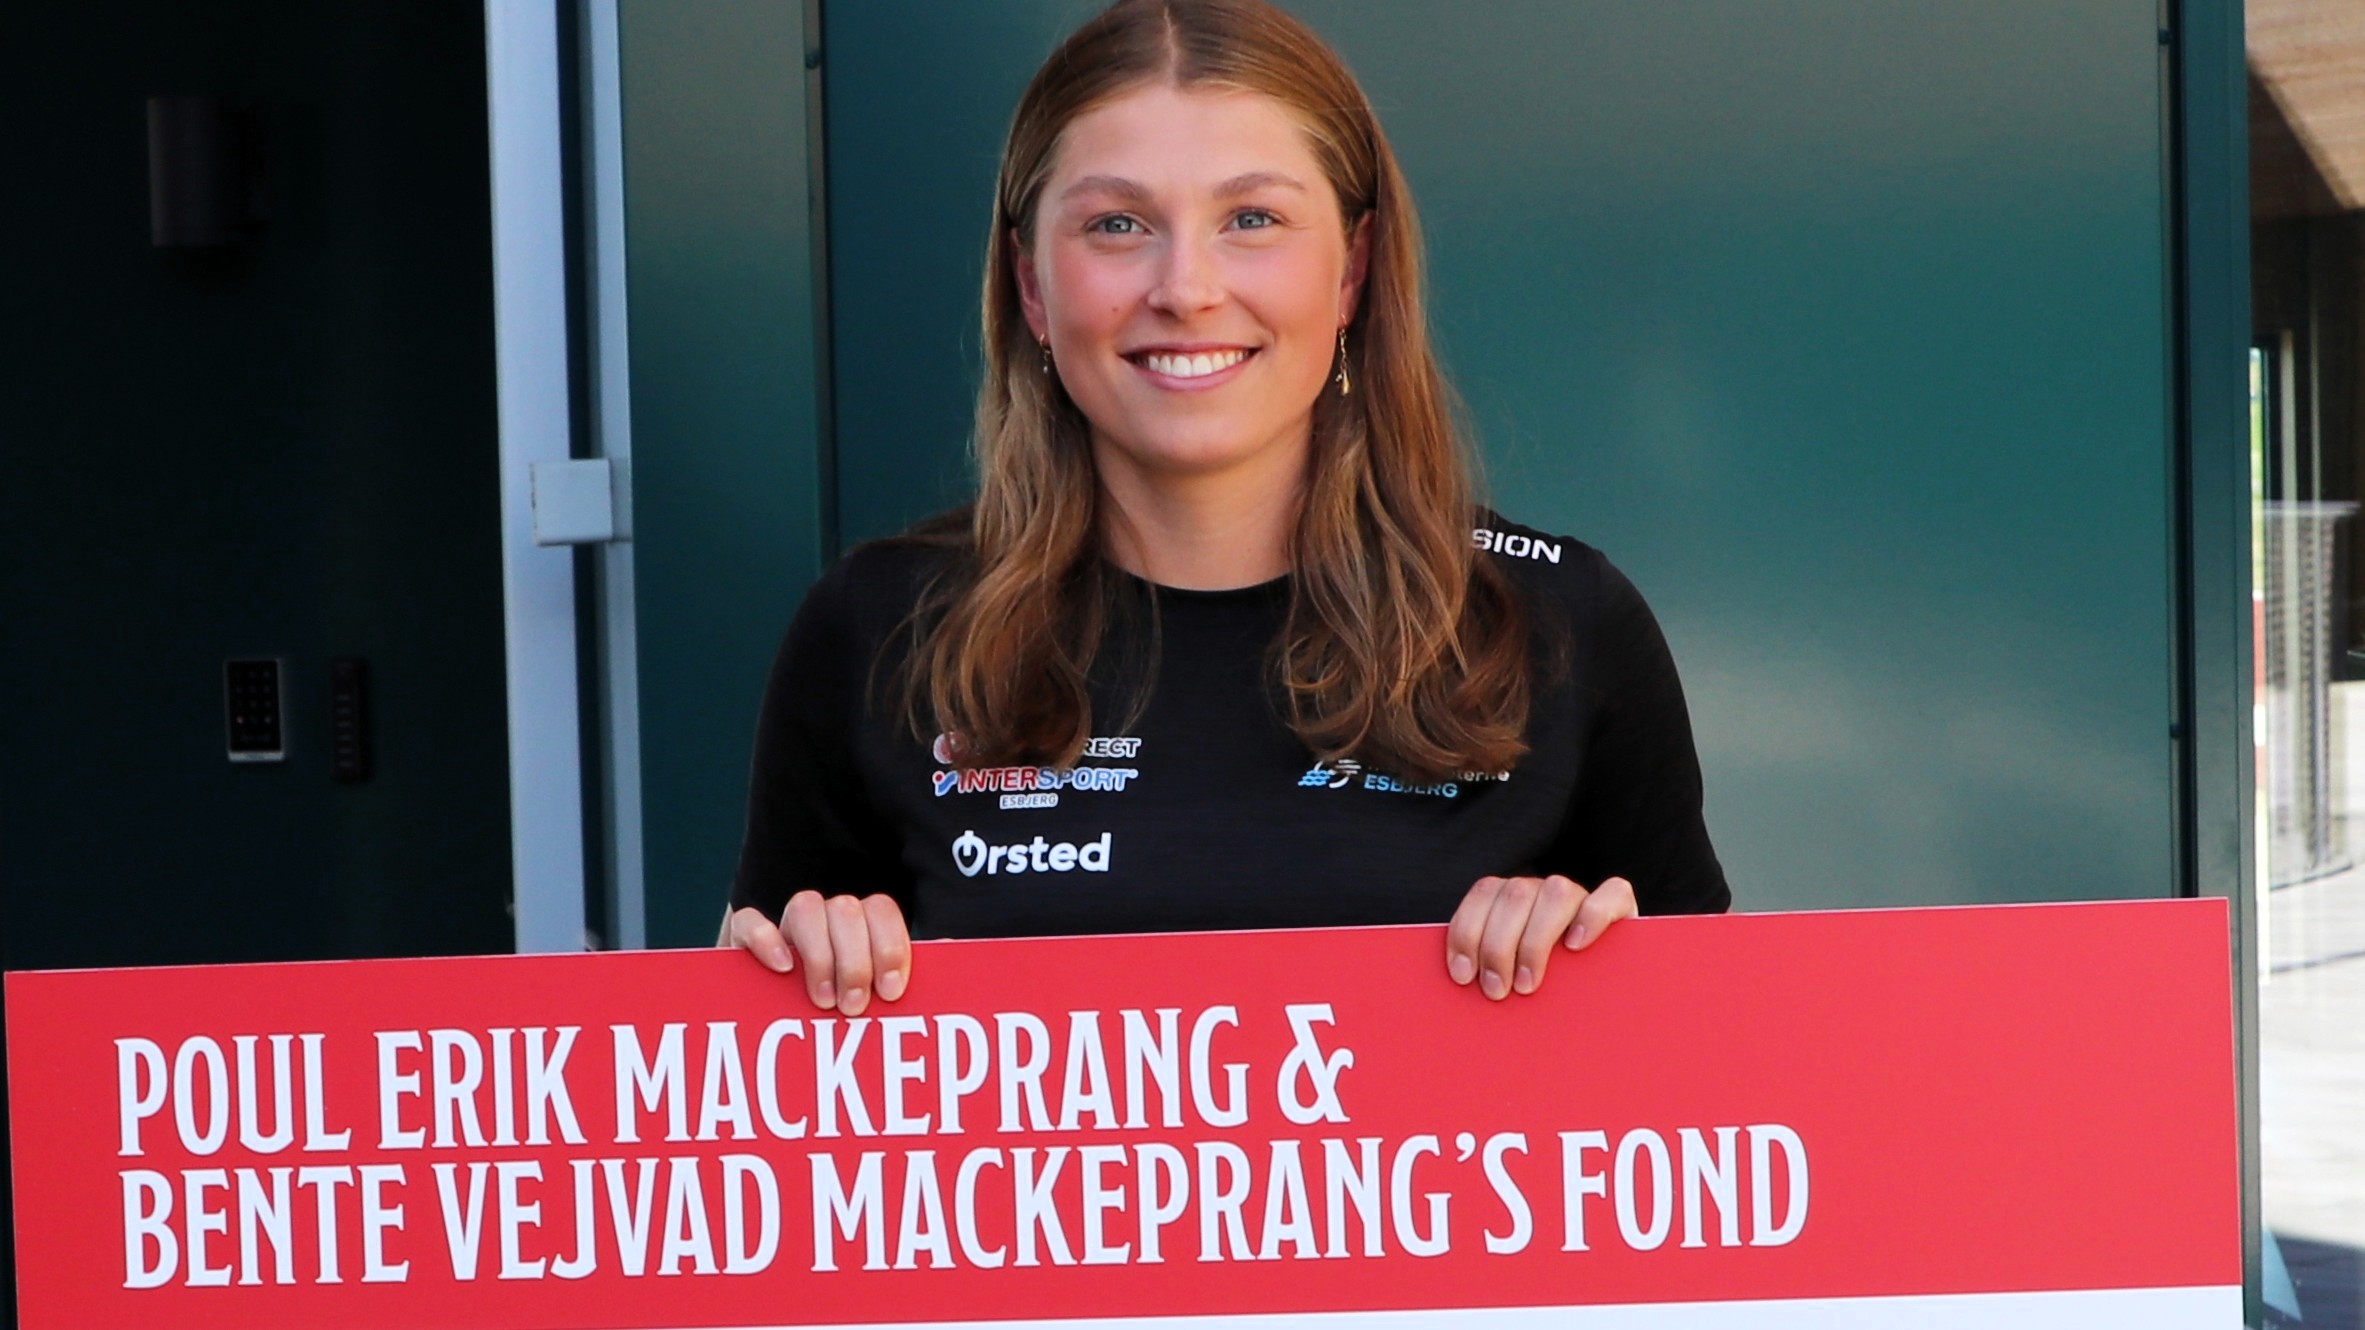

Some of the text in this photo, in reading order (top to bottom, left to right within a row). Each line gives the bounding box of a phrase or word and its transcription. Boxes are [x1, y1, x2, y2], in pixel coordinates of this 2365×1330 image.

[957, 767, 1138, 793] INTERSPORT
[1000, 793, 1059, 810] ESBJERG
[952, 830, 1112, 877] Ørsted
[113, 1003, 1354, 1156] POUL ERIK MACKEPRANG &
[118, 1123, 1809, 1289] BENTE VEJVAD MACKEPRANG’S FOND
